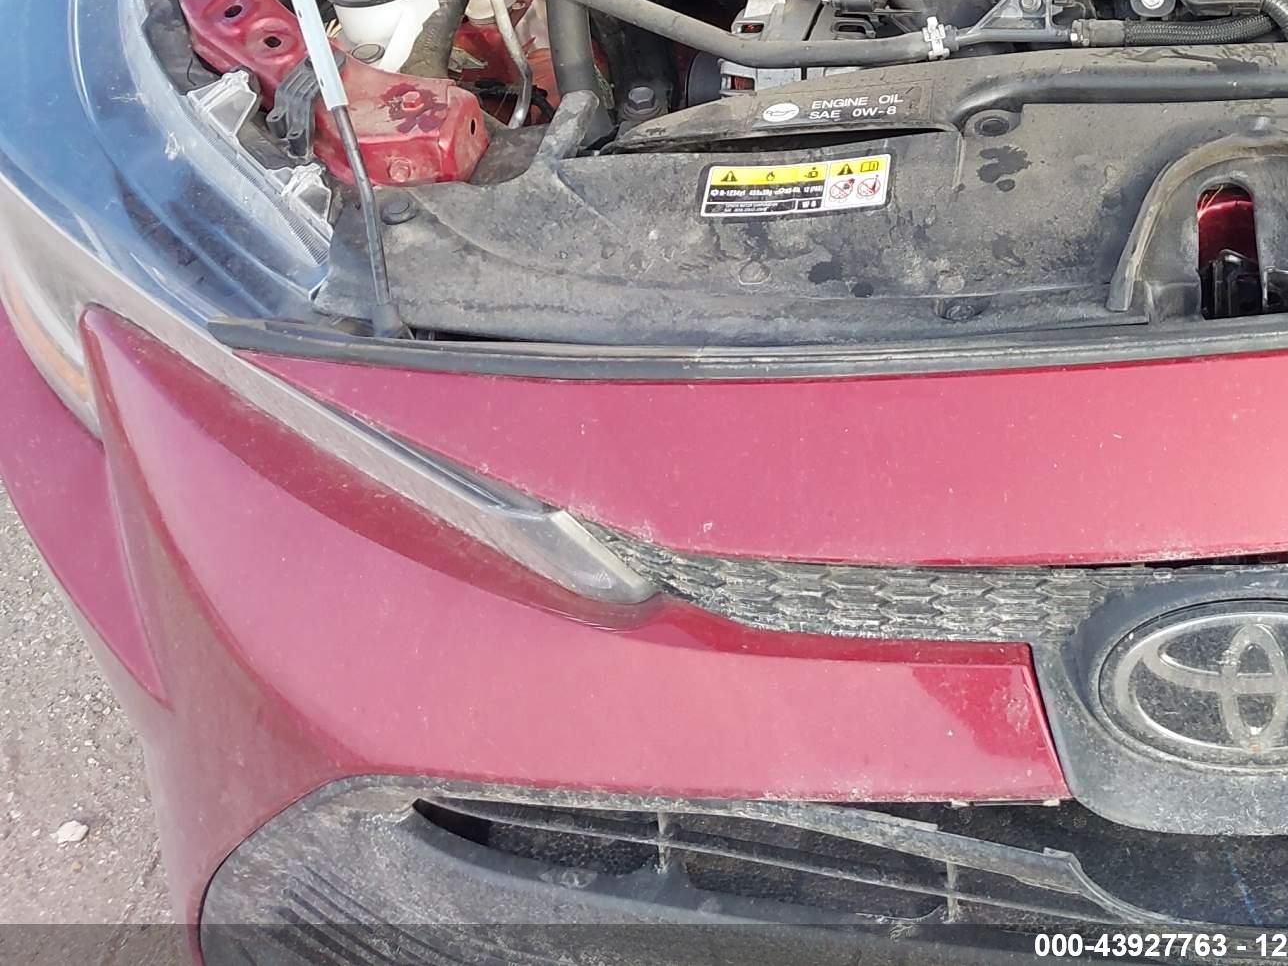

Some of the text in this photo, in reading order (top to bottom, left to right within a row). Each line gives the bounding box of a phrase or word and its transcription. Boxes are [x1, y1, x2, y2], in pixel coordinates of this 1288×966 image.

[811, 93, 905, 110] ENGINE OIL
[809, 105, 898, 121] SAE 0W-8
